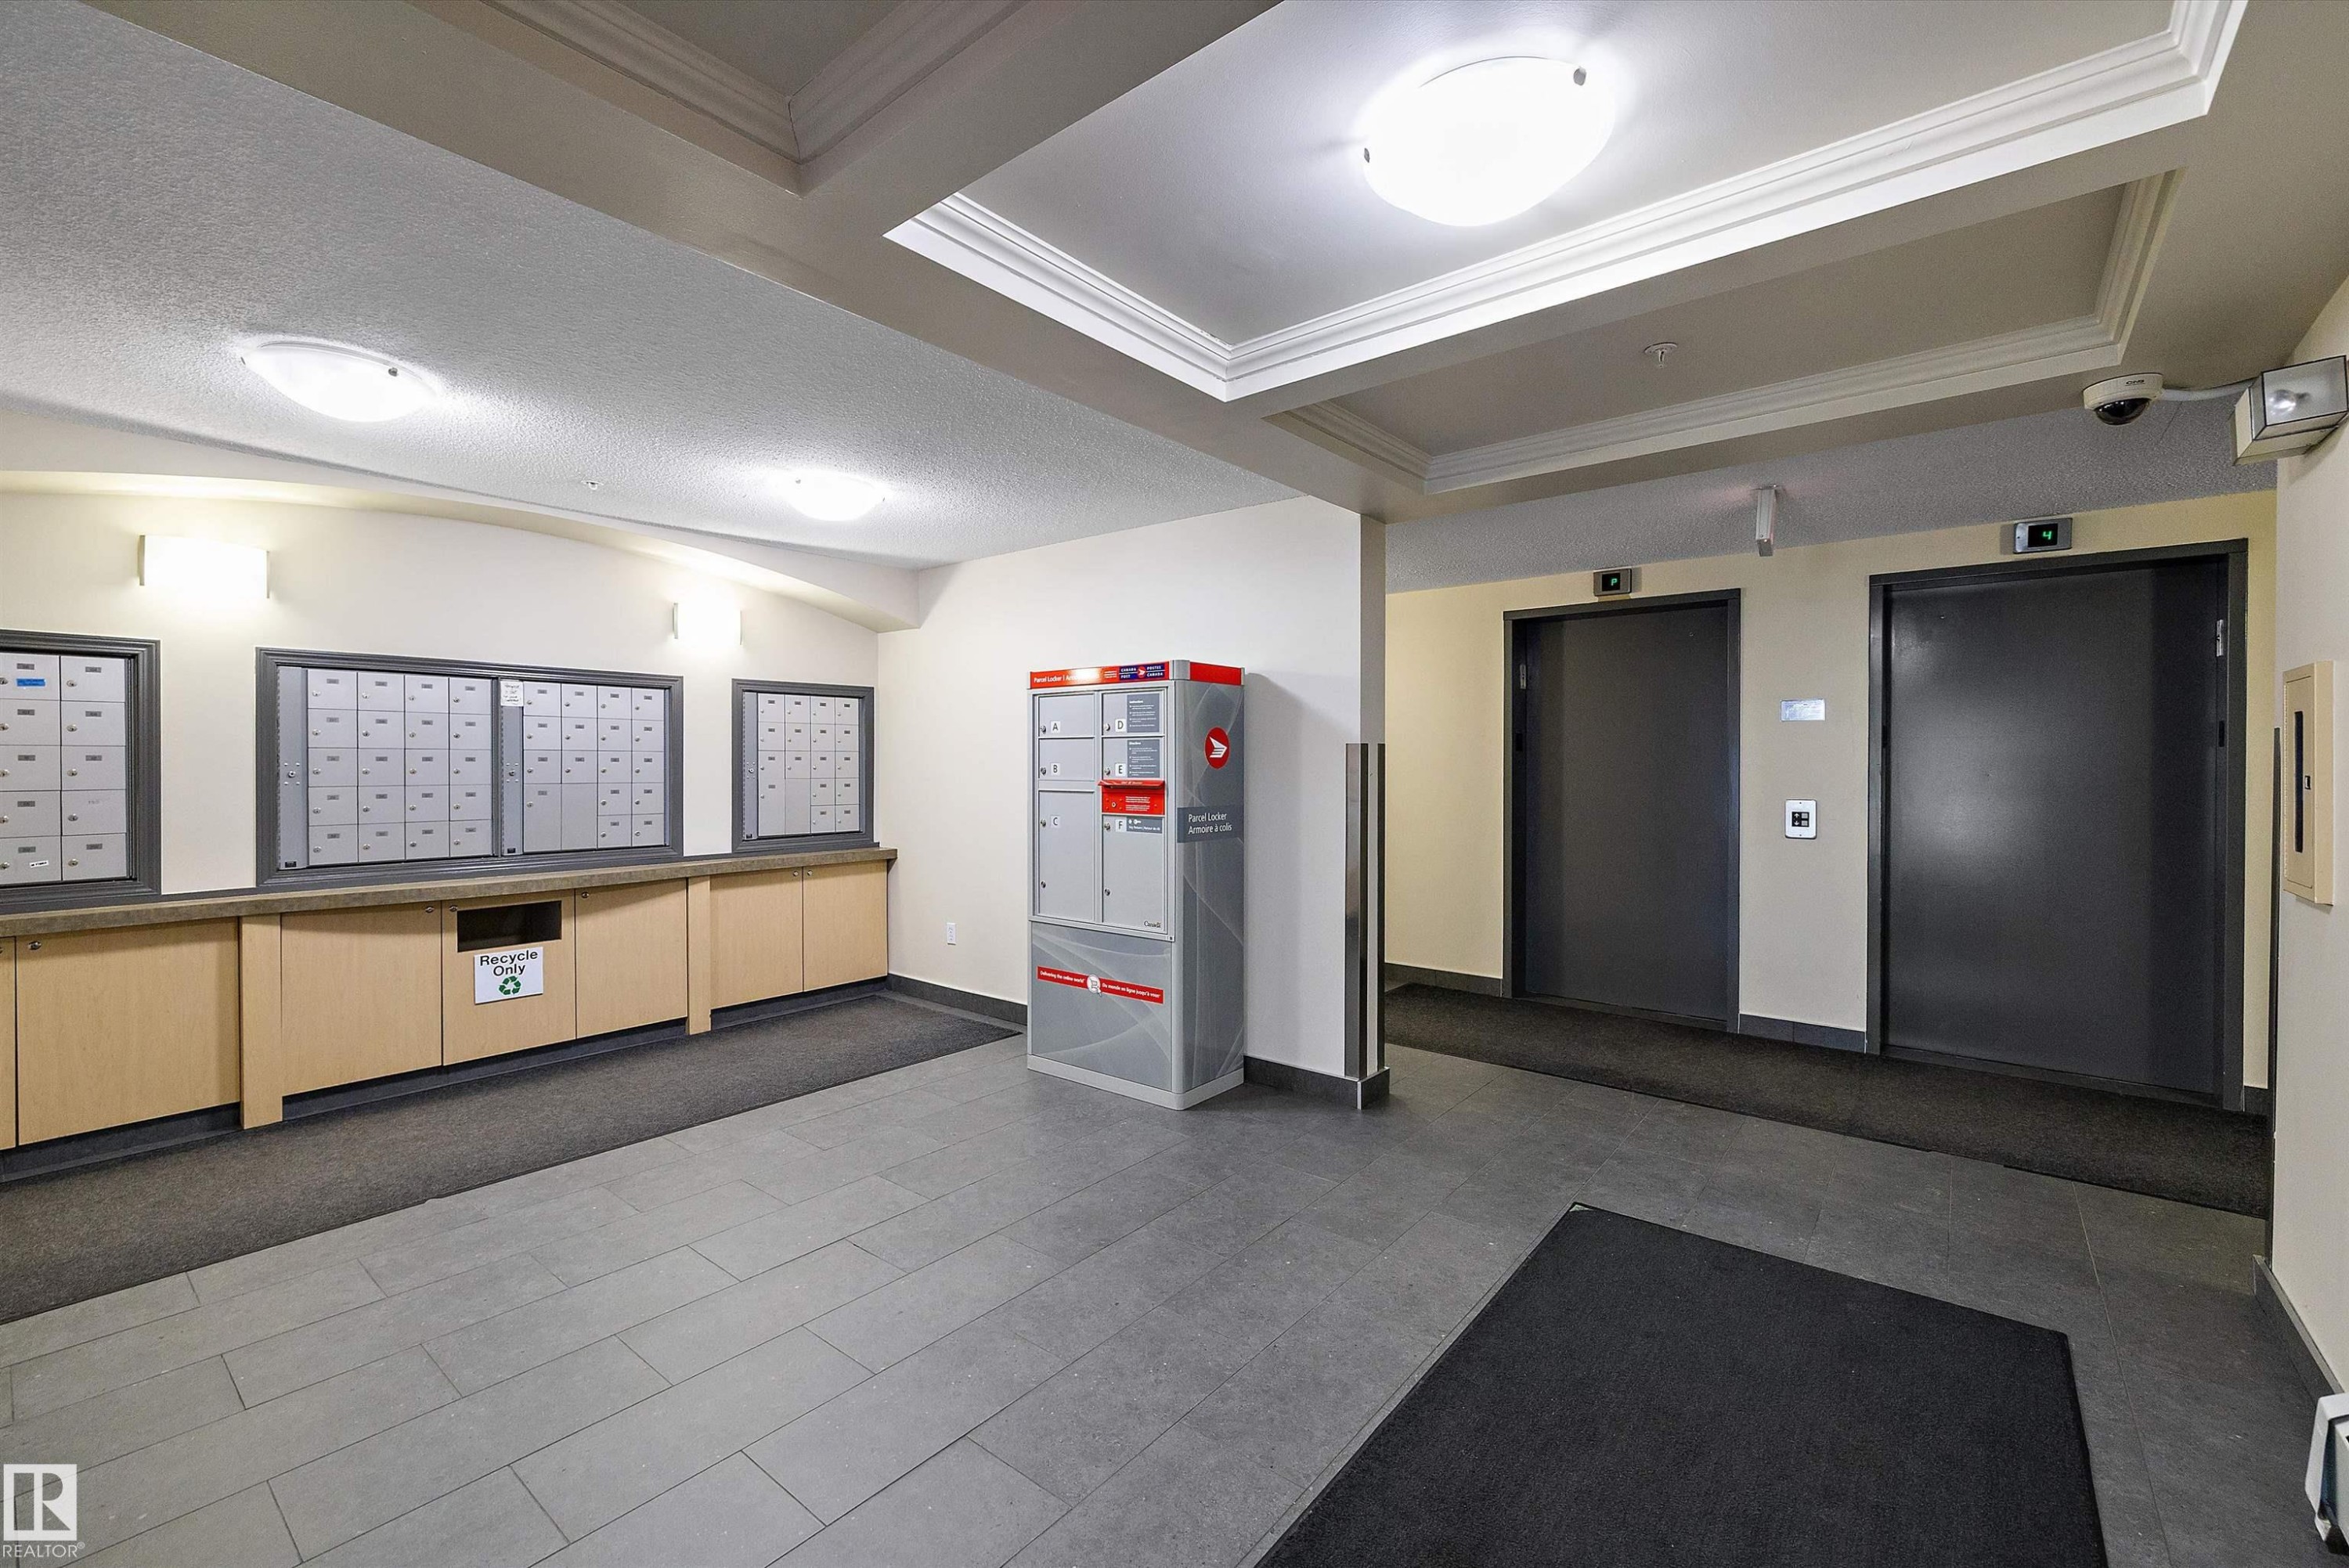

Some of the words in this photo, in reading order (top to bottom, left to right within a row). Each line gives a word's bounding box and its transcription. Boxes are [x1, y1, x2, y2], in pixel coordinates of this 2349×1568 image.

[2042, 530, 2052, 540] 4
[1611, 578, 1618, 586] P
[1052, 723, 1059, 731] A
[1052, 765, 1058, 773] B
[1052, 817, 1058, 826] C
[1188, 813, 1207, 823] Parcel
[1207, 812, 1227, 821] Locker
[1118, 820, 1123, 829] F
[1188, 824, 1213, 834] Armoire
[1214, 824, 1218, 832] à
[1219, 822, 1232, 832] colis
[1143, 920, 1161, 928] Canada
[480, 950, 538, 966] Recycle
[493, 964, 526, 976] Only
